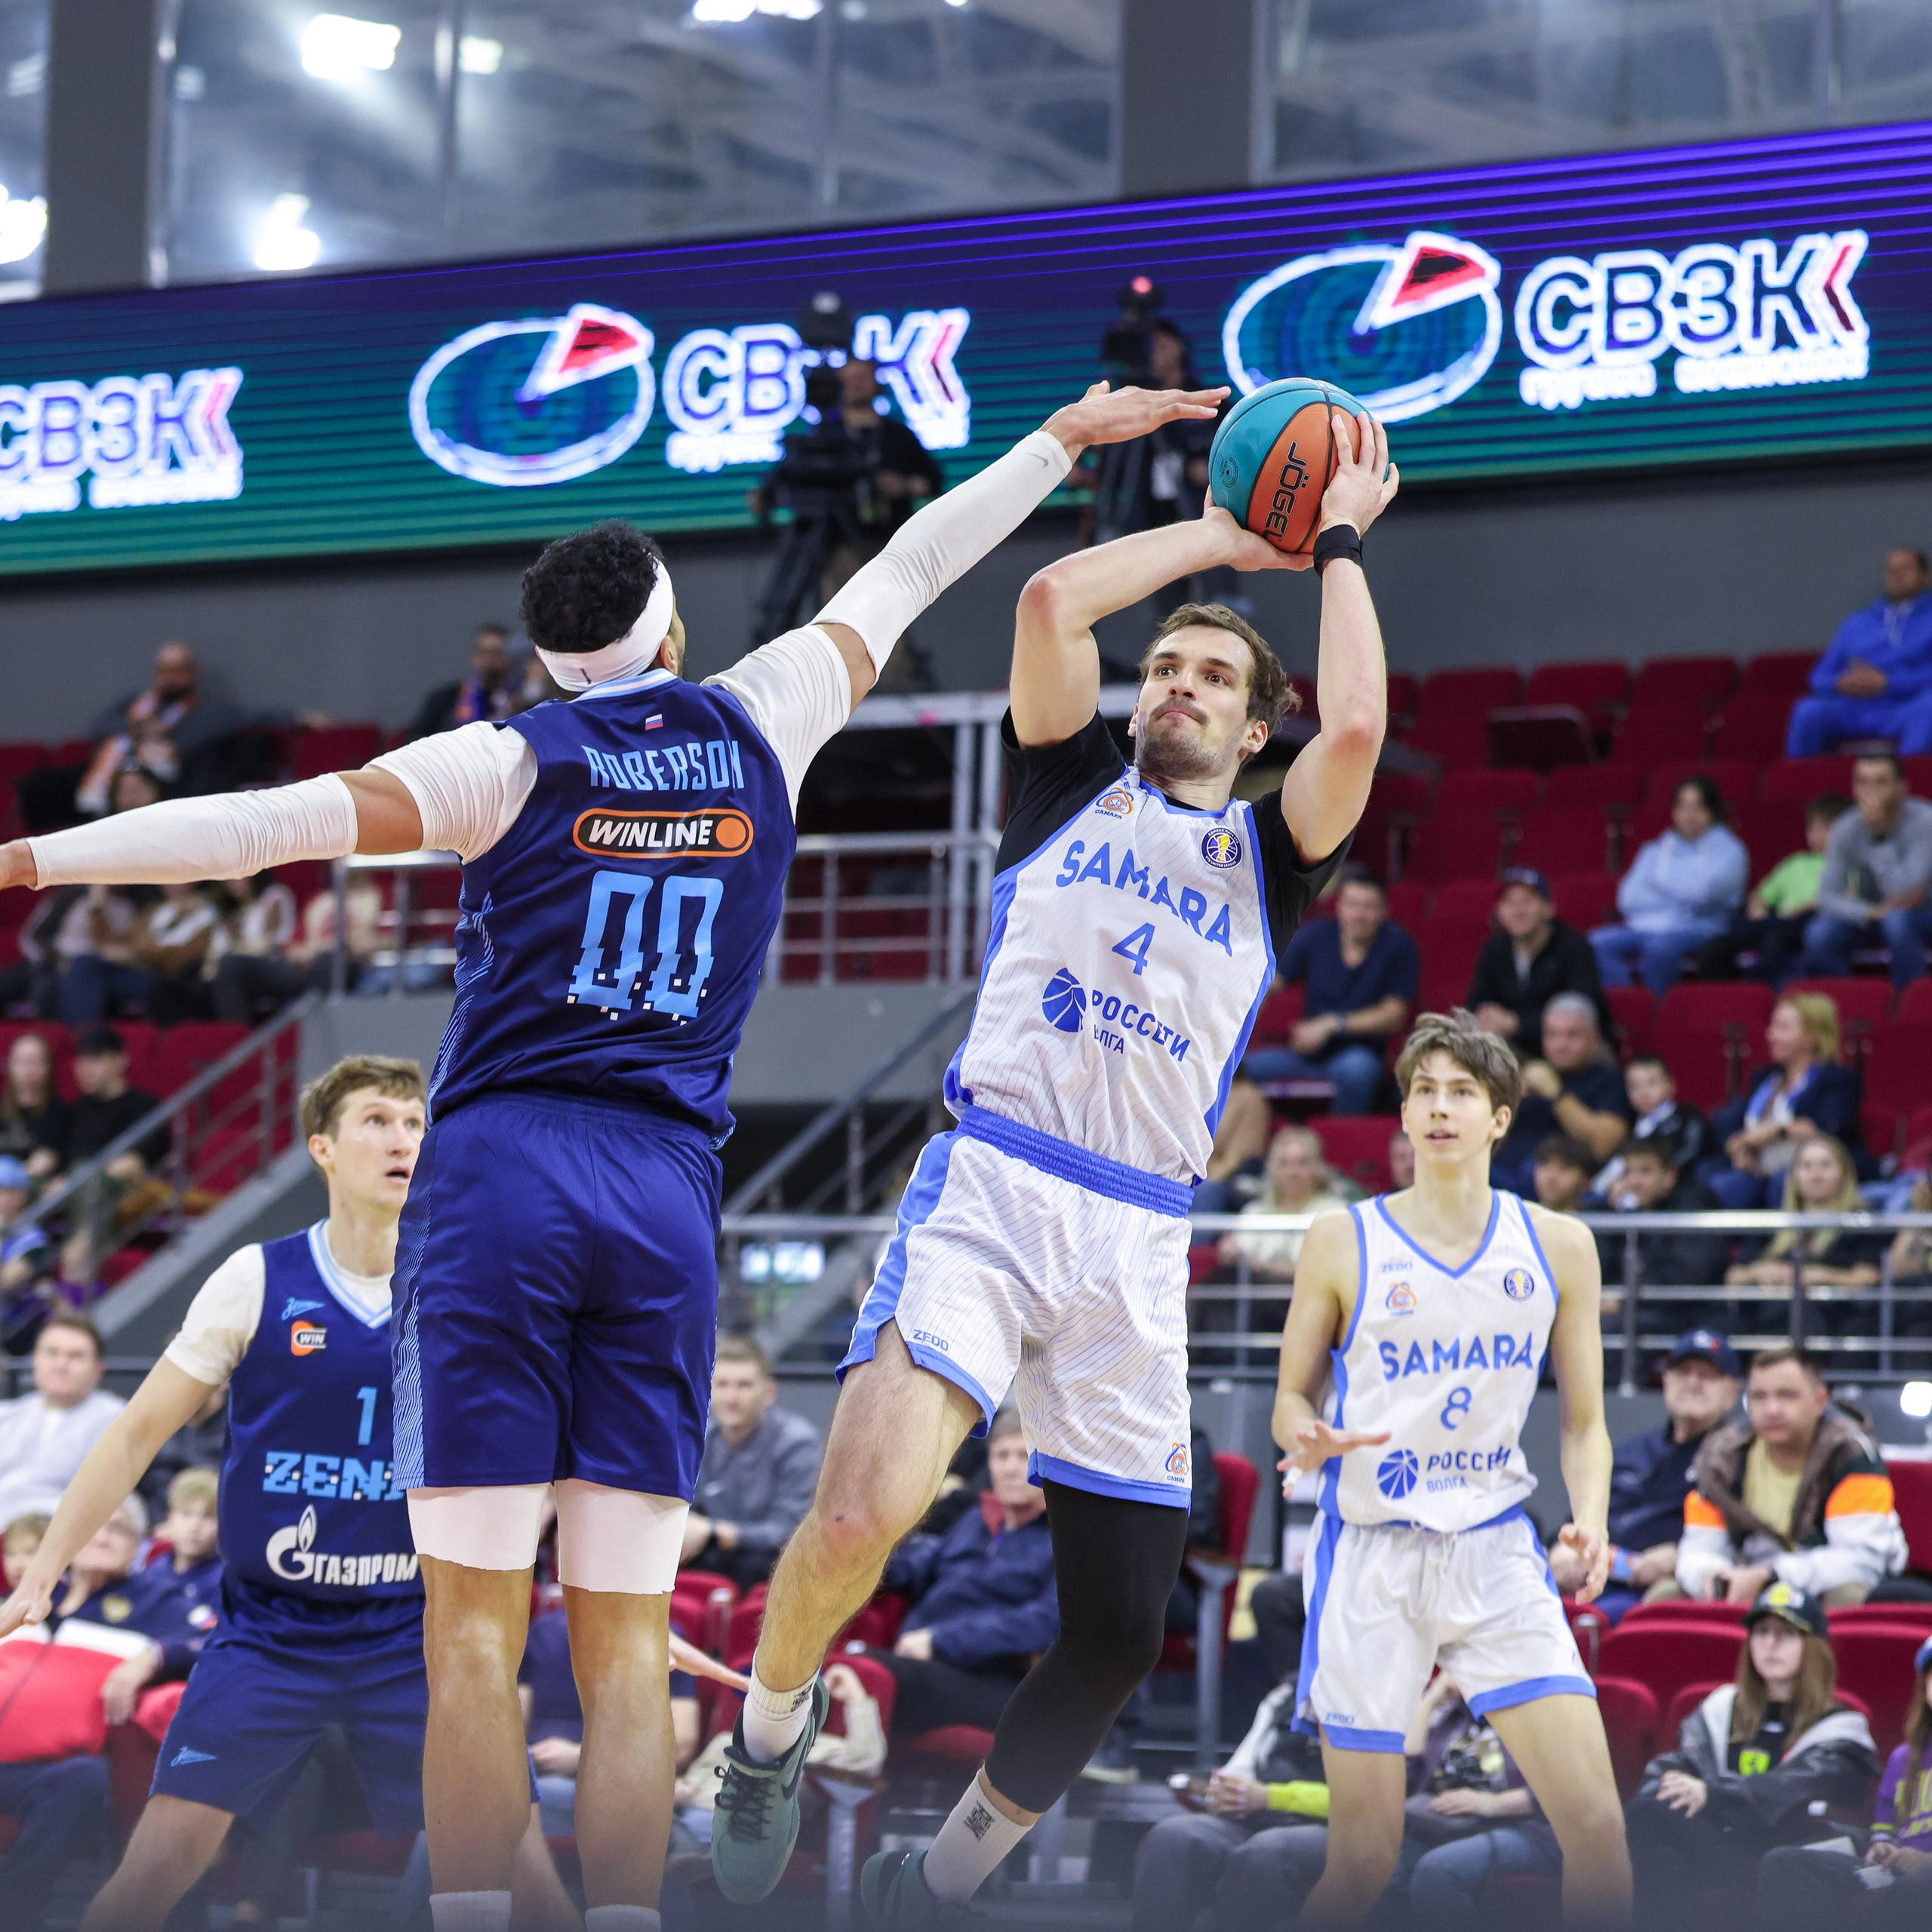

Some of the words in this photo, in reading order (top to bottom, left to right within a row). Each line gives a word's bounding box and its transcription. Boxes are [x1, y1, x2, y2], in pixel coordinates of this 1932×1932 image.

[663, 300, 971, 435] СВК
[581, 740, 745, 791] ROBERSON
[589, 819, 713, 848] WINLINE
[1056, 840, 1232, 957] SAMARA
[568, 869, 724, 1020] 00
[1112, 922, 1155, 976] 4
[300, 1334, 325, 1344] WIN
[1379, 1331, 1534, 1382] SAMARA
[356, 1386, 377, 1446] 1
[1440, 1386, 1472, 1431] 8
[313, 1552, 419, 1587] ГАЗПРОМ
